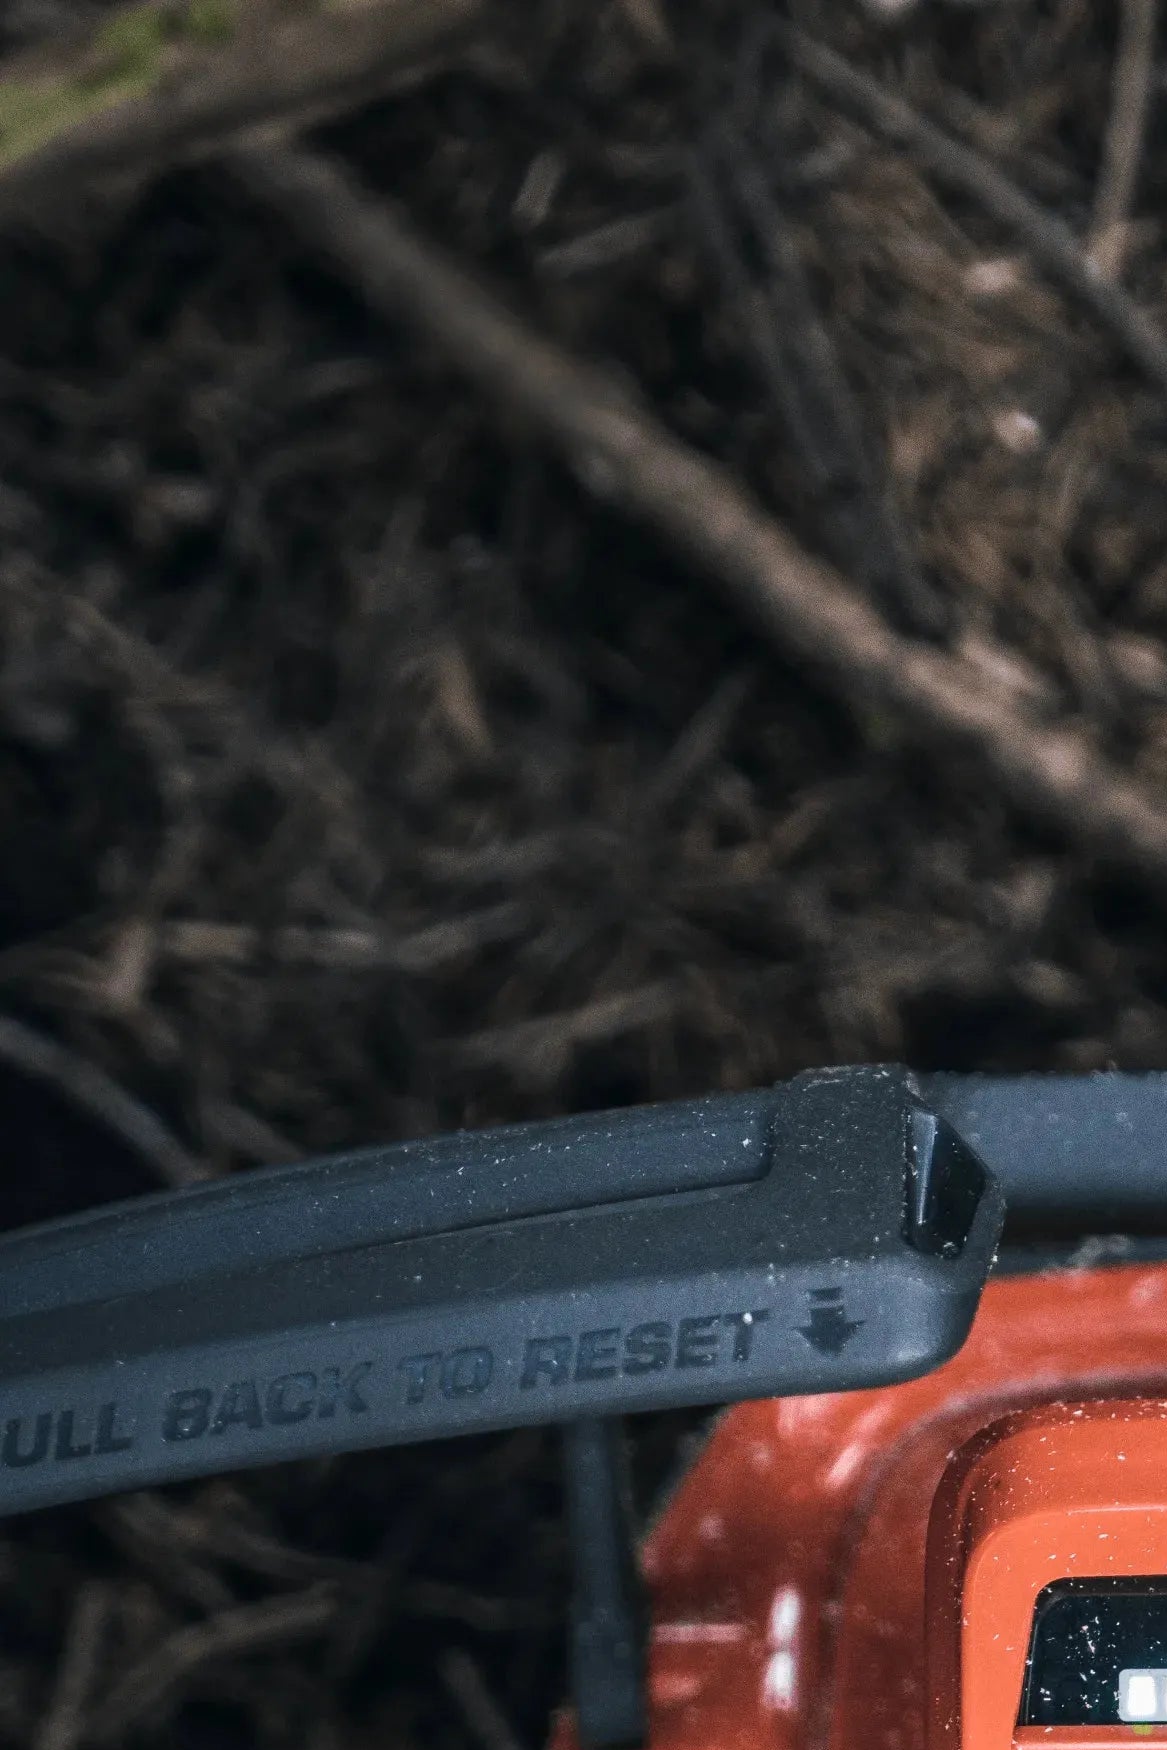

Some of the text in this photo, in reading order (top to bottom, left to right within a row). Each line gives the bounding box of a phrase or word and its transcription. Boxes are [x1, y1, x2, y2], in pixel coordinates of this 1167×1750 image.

[163, 1361, 373, 1442] BACK
[398, 1346, 495, 1405] TO
[520, 1308, 769, 1390] RESET
